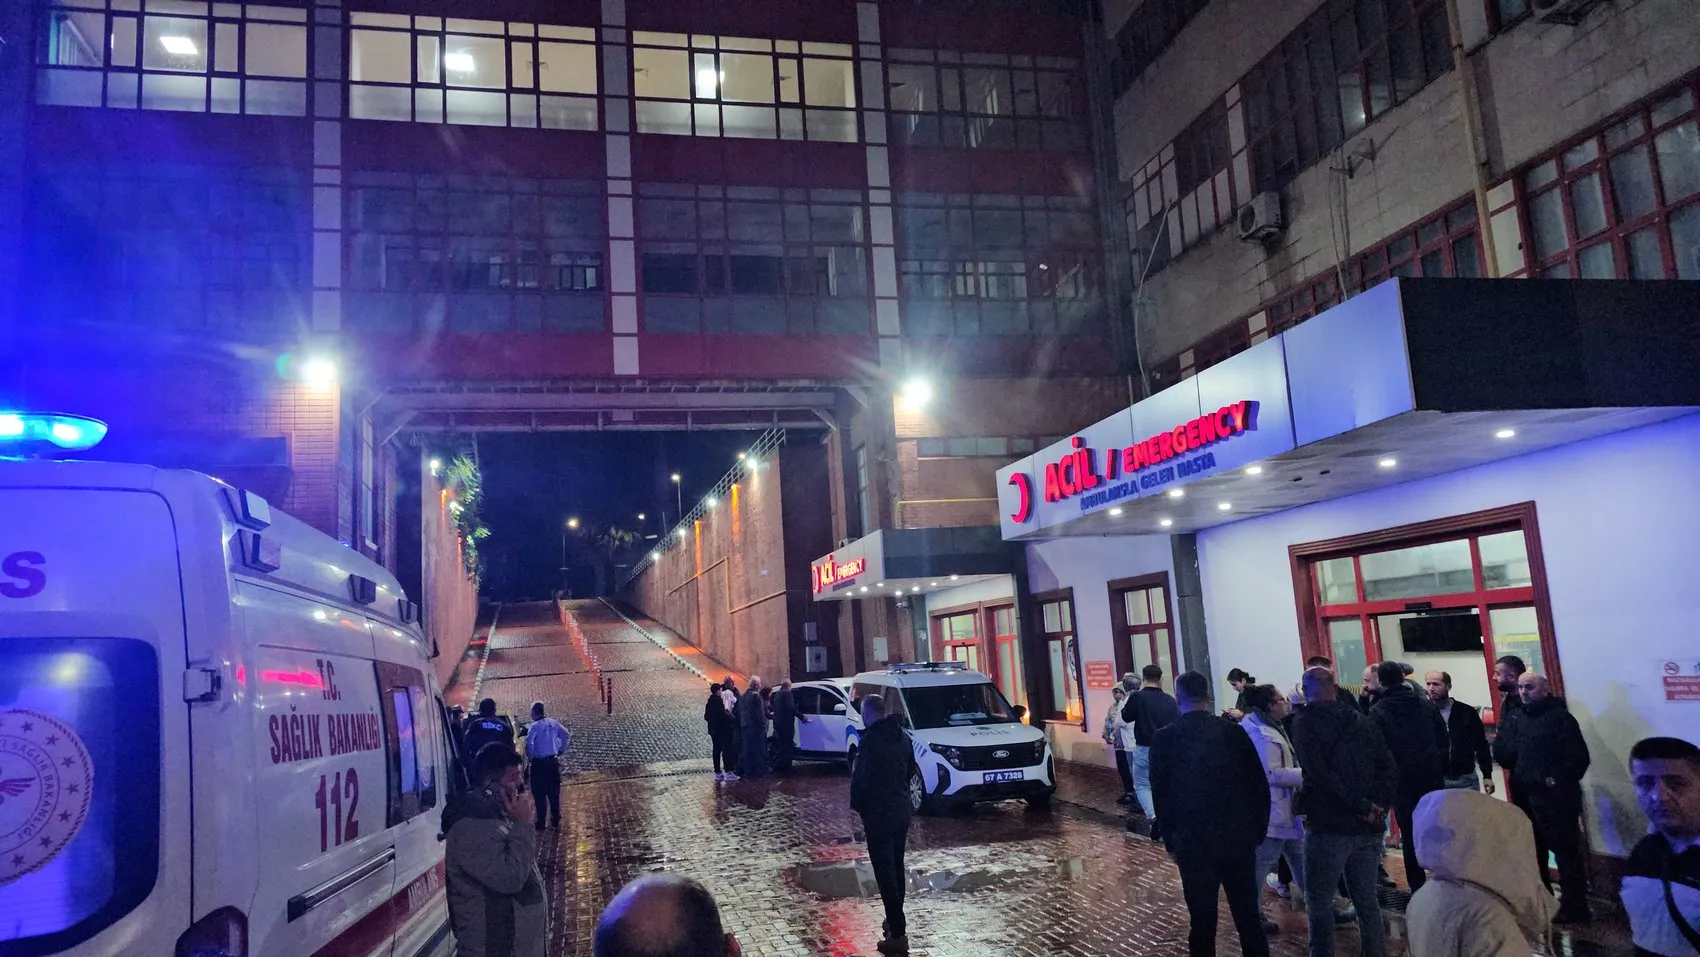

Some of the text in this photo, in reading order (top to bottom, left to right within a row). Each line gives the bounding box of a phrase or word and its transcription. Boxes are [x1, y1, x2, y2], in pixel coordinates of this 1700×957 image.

[1044, 437, 1101, 502] ACİL
[1123, 400, 1251, 473] EMERGENCY
[1140, 466, 1174, 490] GELEN
[1177, 452, 1216, 478] HASTA
[316, 659, 341, 700] T.C.
[269, 704, 381, 764] SAĞLIK BAKANLIĞI
[315, 767, 359, 852] 112
